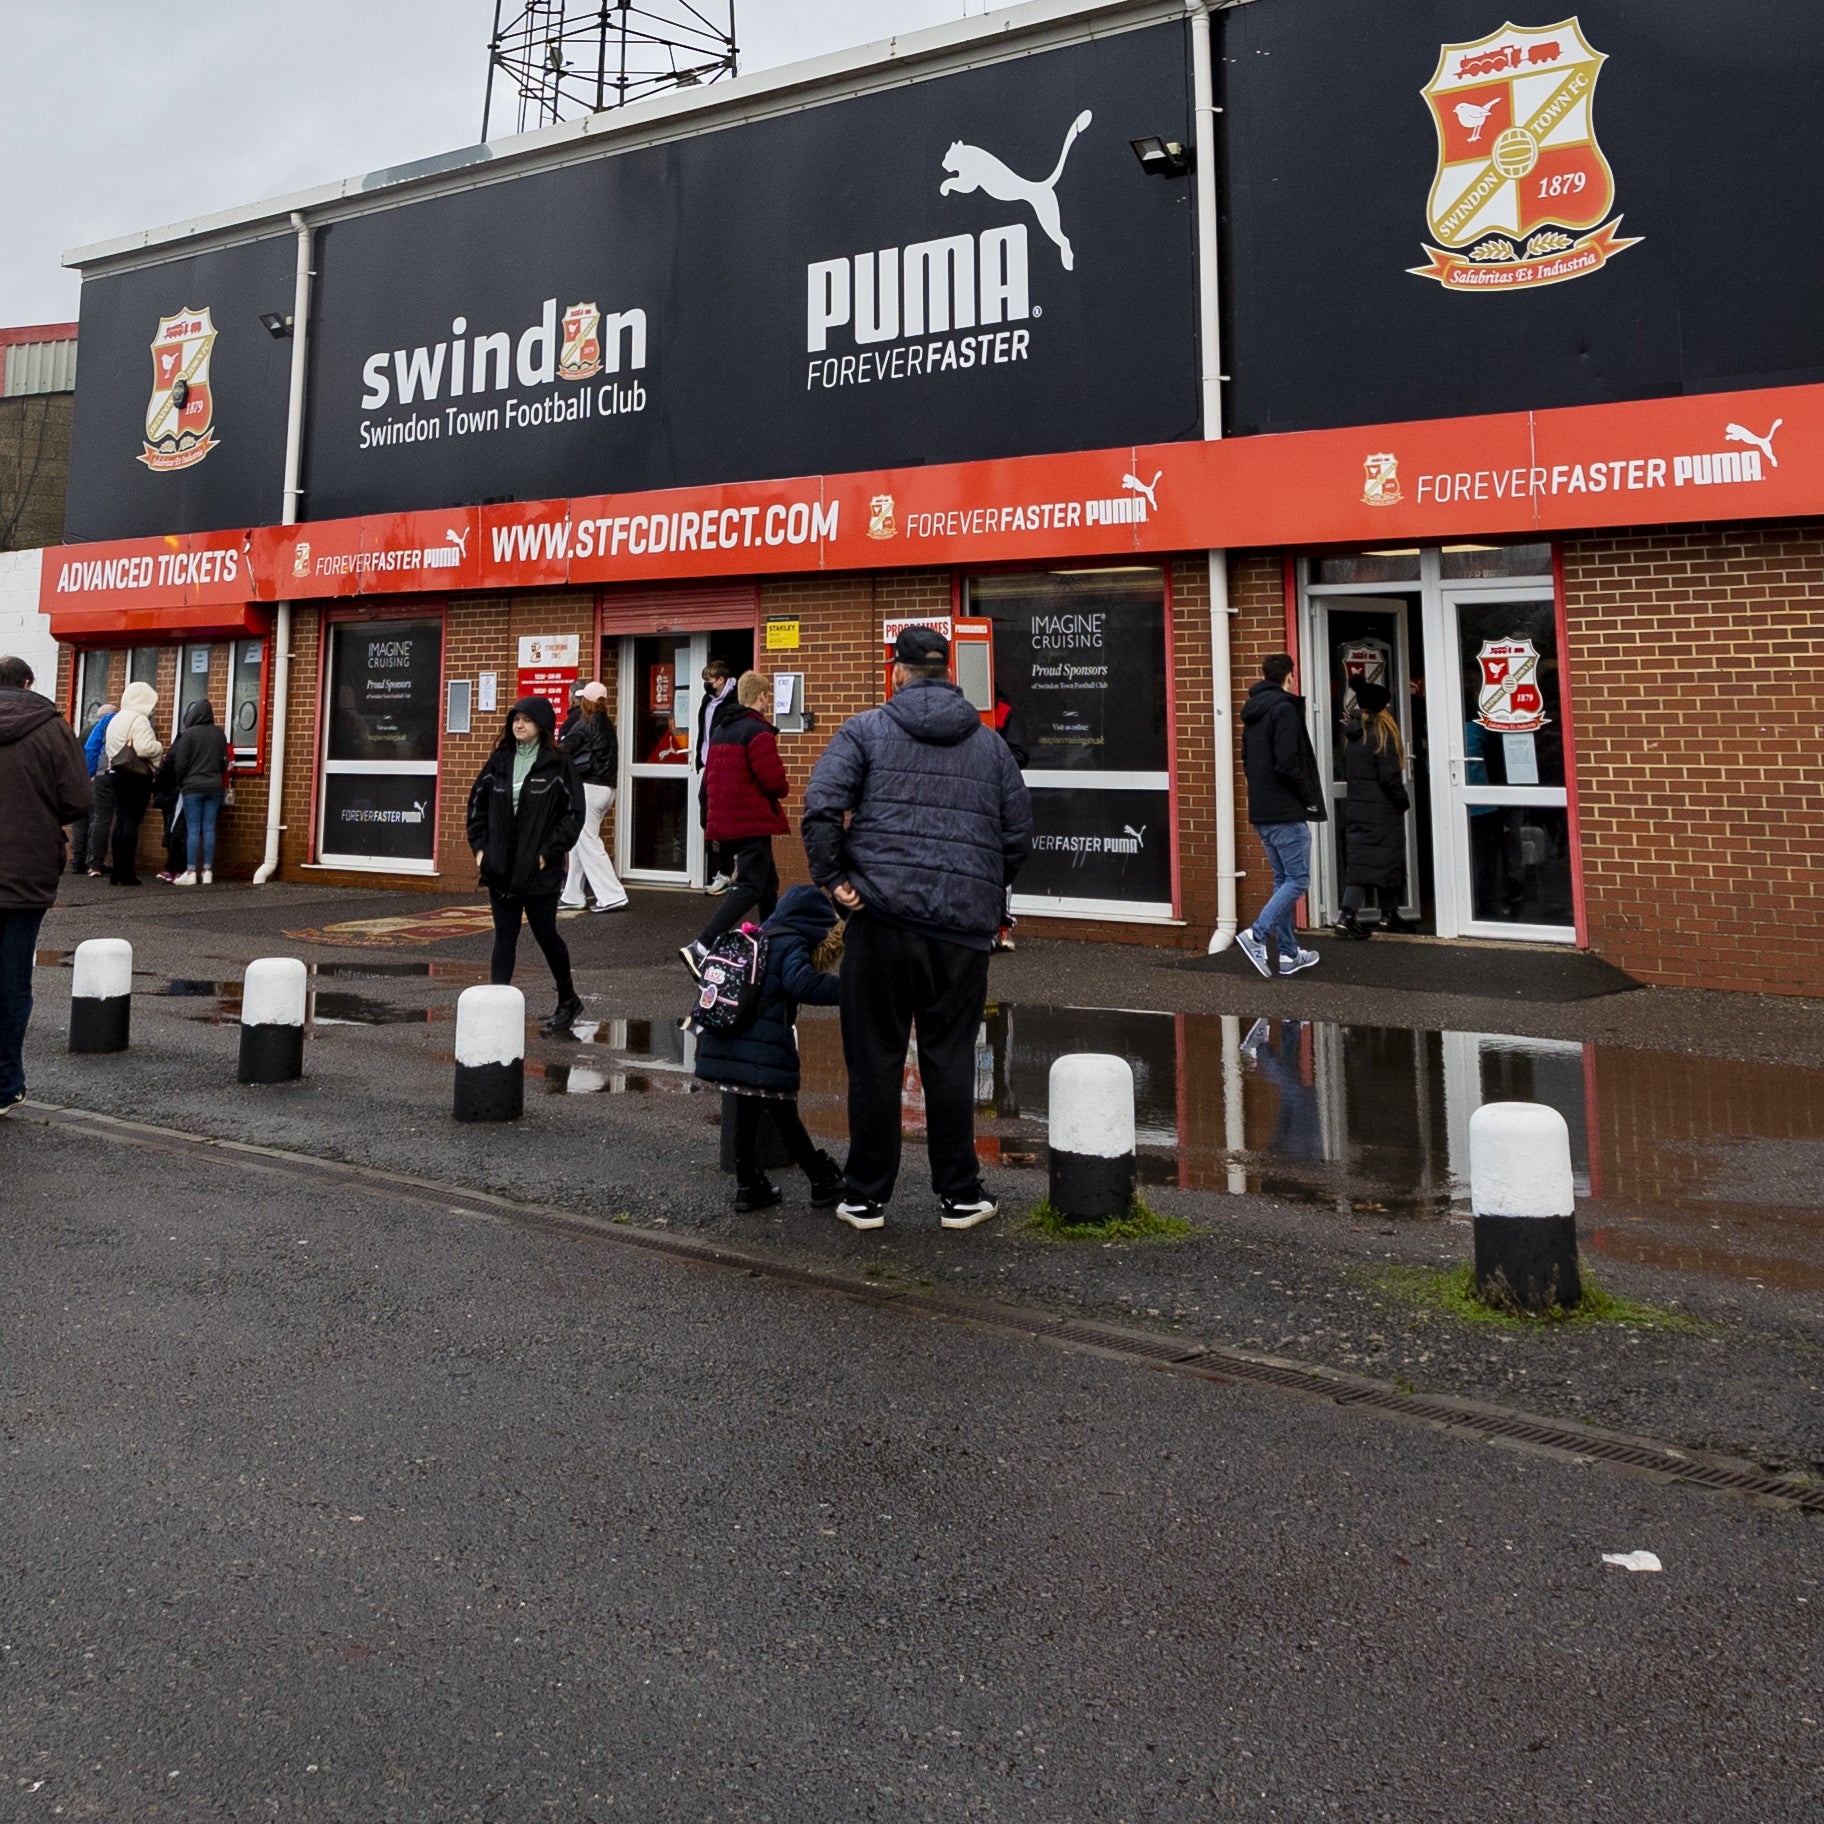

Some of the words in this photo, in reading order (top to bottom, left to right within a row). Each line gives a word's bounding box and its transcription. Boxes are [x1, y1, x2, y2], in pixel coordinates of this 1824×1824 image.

[1530, 93, 1573, 134] TOWN
[1567, 72, 1589, 97] FC
[1538, 172, 1586, 198] 1879
[1439, 172, 1499, 238] SWINDON
[1450, 269, 1513, 285] Salubritas
[1516, 268, 1533, 281] Et
[1537, 252, 1597, 279] Industria
[807, 223, 1029, 353] PUMA
[361, 298, 647, 410] swindn
[185, 400, 204, 415] 1879
[359, 413, 440, 449] Swindon
[446, 406, 499, 436] Town
[505, 386, 592, 429] Football
[598, 379, 646, 417] Club
[1673, 450, 1762, 487] PUMA
[1085, 497, 1146, 526] PUMA
[491, 500, 840, 563] WWW.STFCDIRECT.COM
[423, 546, 460, 568] PUMA
[56, 556, 154, 593] ADVANCED
[157, 548, 238, 587] TICKETS
[886, 621, 949, 638] PROMES
[1031, 613, 1102, 634] IMAGINE
[368, 641, 411, 656] IMAGINE
[1031, 634, 1103, 649] CRUISING
[367, 656, 410, 668] CRUISING
[1032, 663, 1062, 677] Proud
[1063, 663, 1108, 680] Sponsors
[366, 679, 385, 690] Proud
[385, 679, 412, 692] Sponsors
[1516, 693, 1534, 702] 1879
[1104, 838, 1138, 853] PUMA
